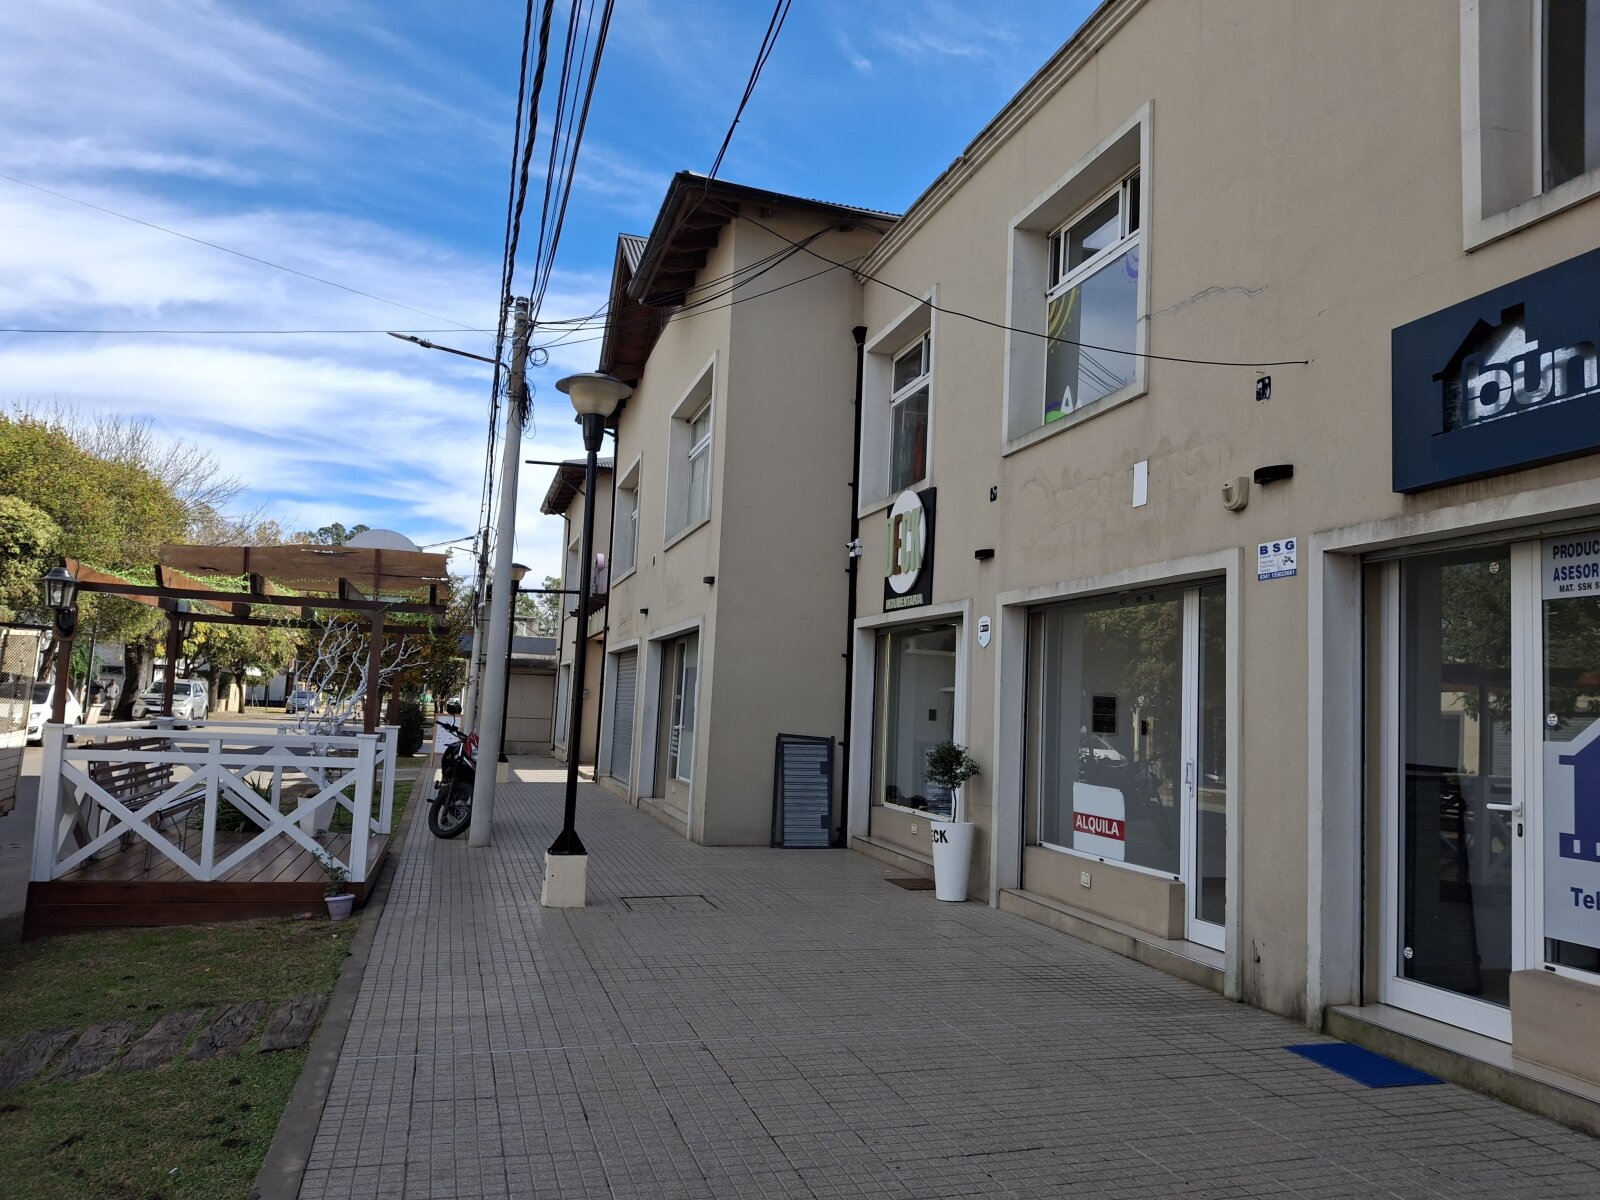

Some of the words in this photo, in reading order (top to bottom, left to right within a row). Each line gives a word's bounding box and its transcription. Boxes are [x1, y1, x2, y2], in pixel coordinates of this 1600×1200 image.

[1552, 562, 1600, 582] ASESOR
[1559, 583, 1575, 593] MAT.
[1577, 581, 1592, 591] SSN
[885, 593, 924, 610] INDUMENTARIA
[1075, 814, 1120, 837] ALQUILA
